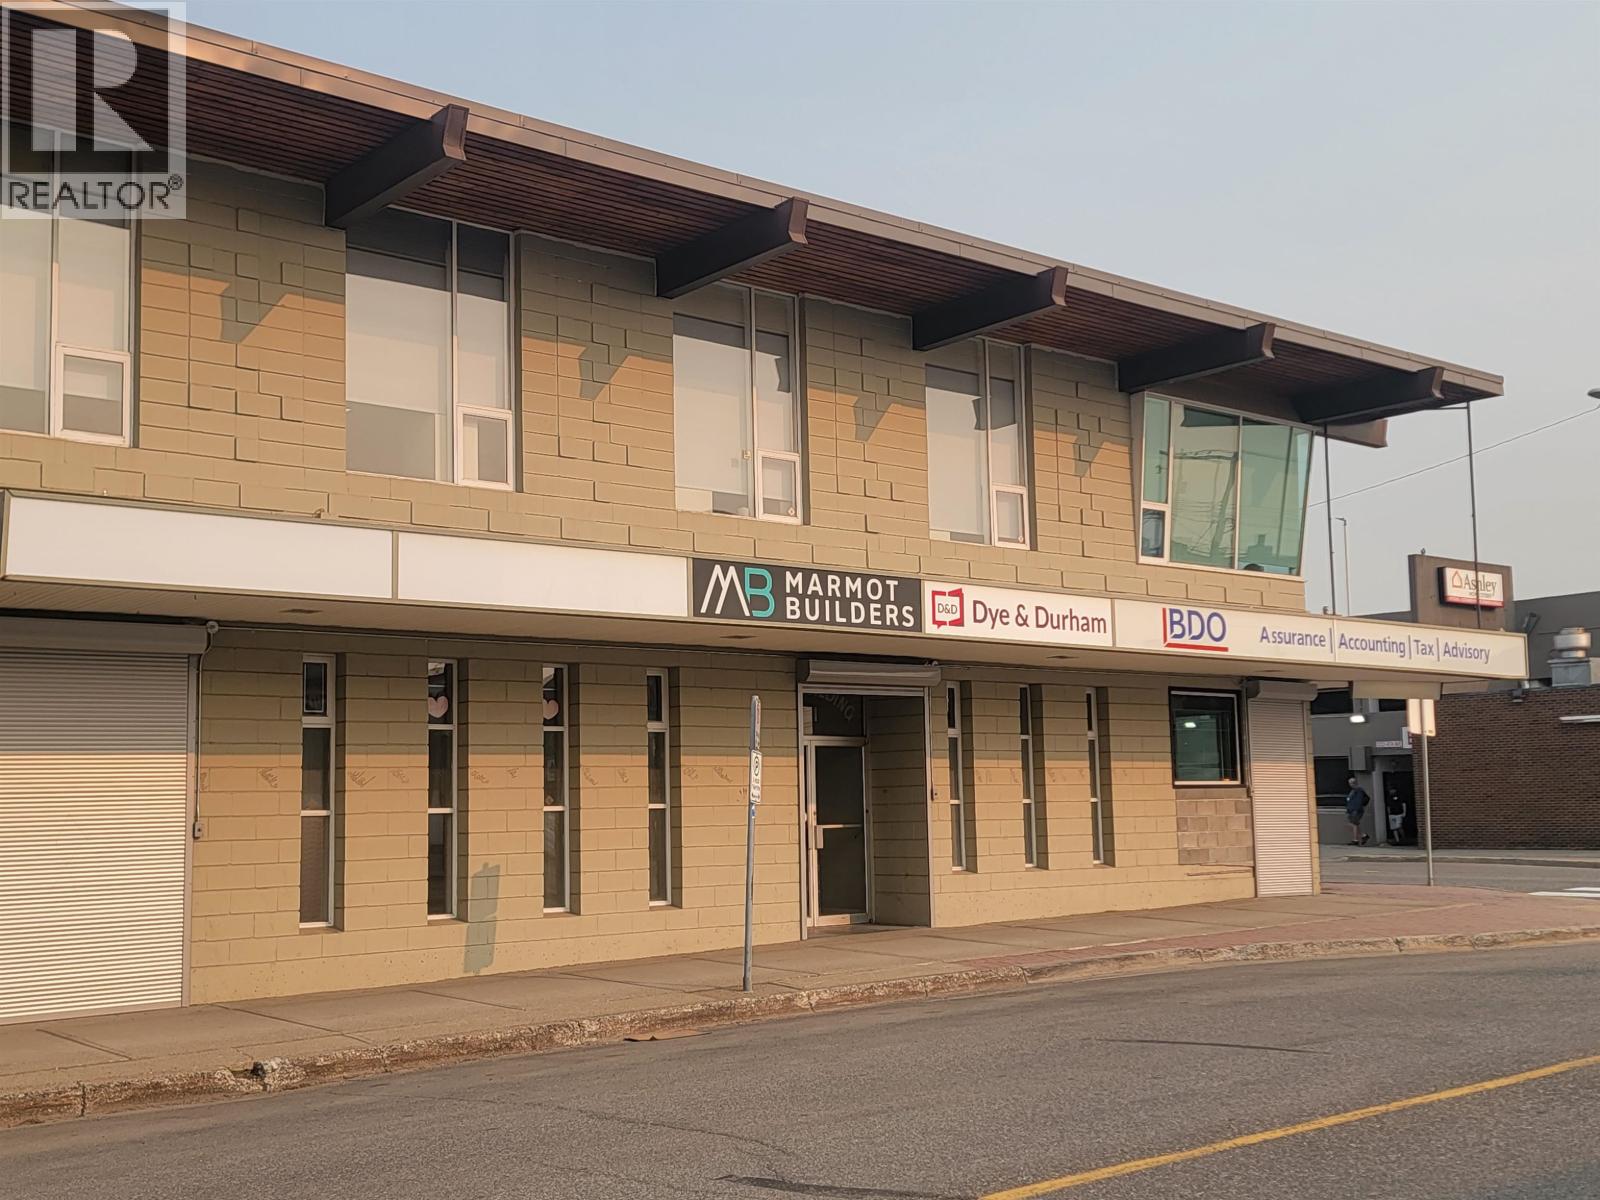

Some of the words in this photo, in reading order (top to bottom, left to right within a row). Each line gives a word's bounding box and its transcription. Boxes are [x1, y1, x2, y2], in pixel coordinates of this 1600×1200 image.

[700, 564, 776, 618] MB
[785, 570, 899, 602] MARMOT
[785, 596, 915, 628] BUILDERS
[937, 602, 958, 615] D&D
[972, 600, 1010, 630] Dye
[1015, 603, 1030, 628] &
[1035, 605, 1107, 634] Durham
[1169, 608, 1227, 643] BDO
[1259, 626, 1327, 648] Assurance
[1338, 633, 1406, 658] Accounting
[1413, 638, 1435, 656] Tax
[1443, 642, 1491, 665] Advisory
